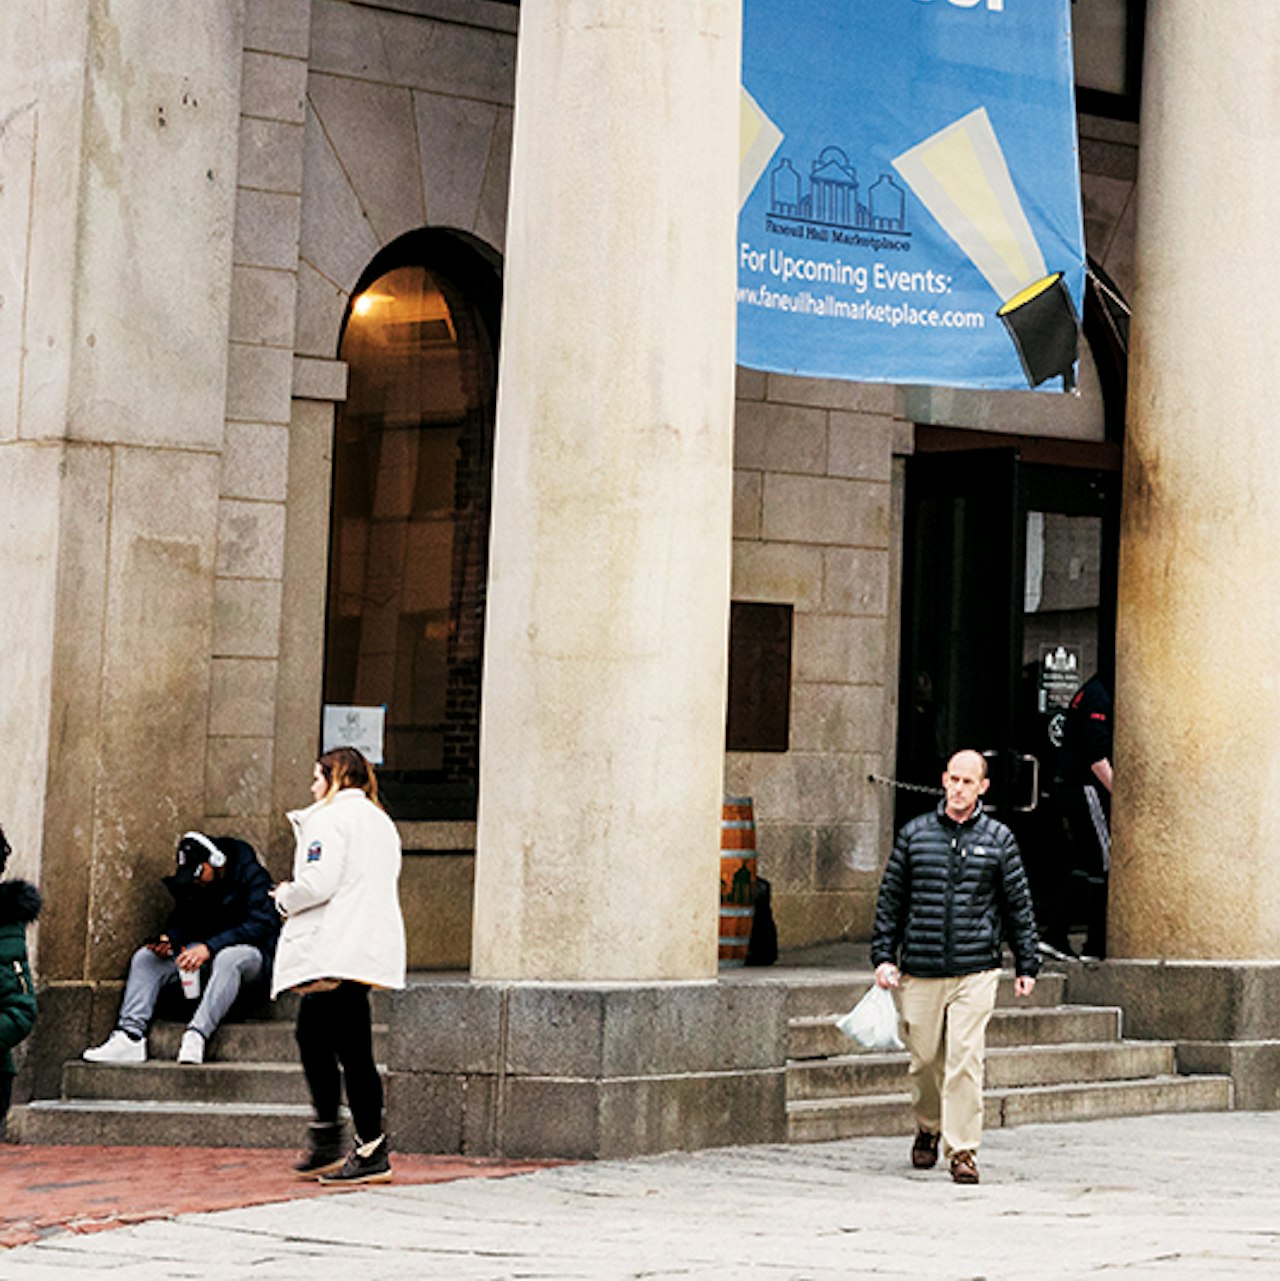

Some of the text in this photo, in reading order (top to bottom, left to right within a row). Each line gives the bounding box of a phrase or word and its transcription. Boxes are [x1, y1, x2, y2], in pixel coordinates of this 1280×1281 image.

[831, 230, 911, 252] Marketplace
[740, 243, 953, 294] For Upcoming Events:
